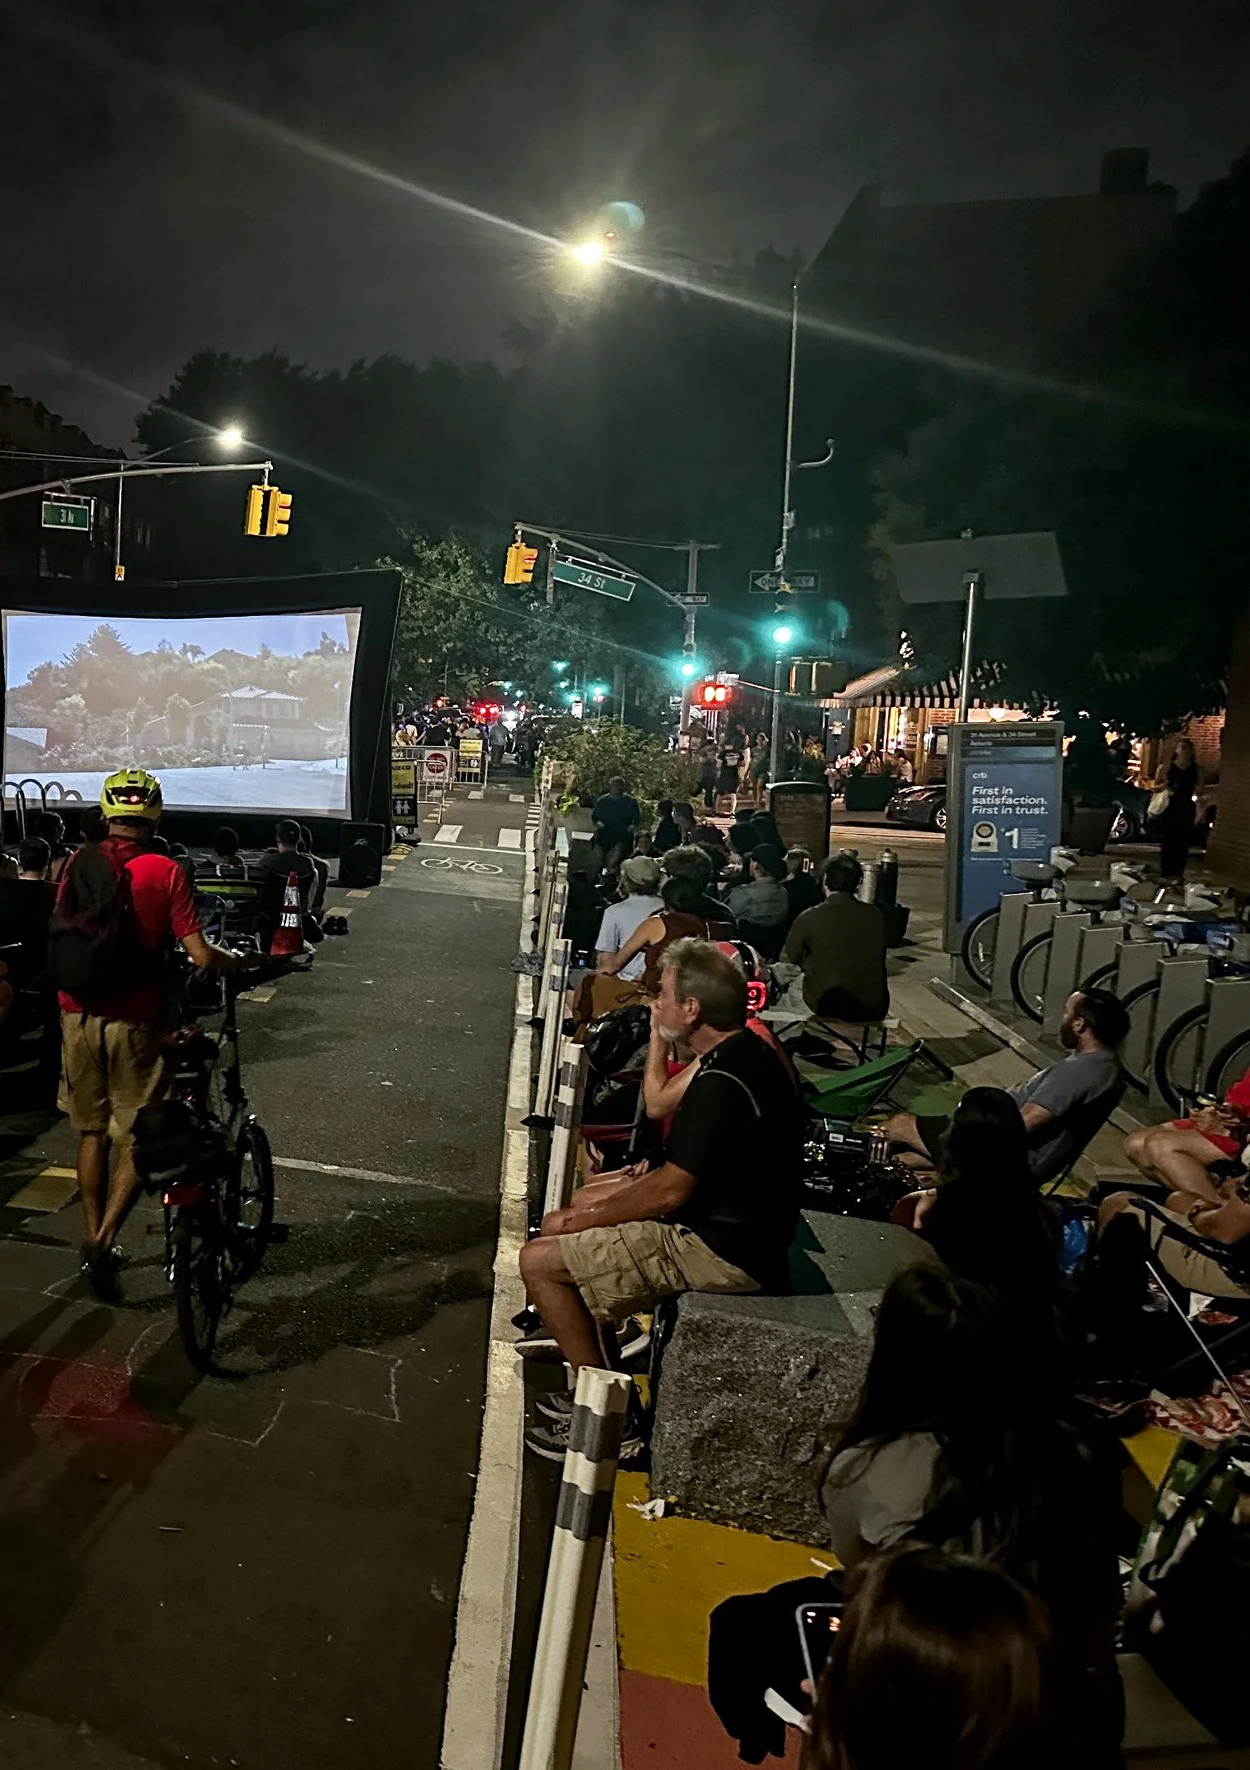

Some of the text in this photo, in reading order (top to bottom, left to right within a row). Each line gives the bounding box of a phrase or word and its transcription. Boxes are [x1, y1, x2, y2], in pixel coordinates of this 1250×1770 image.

[577, 571, 606, 589] 34 St
[971, 786, 1014, 796] First in
[971, 795, 1049, 805] satisfaction.
[971, 805, 1049, 815] First in trust.
